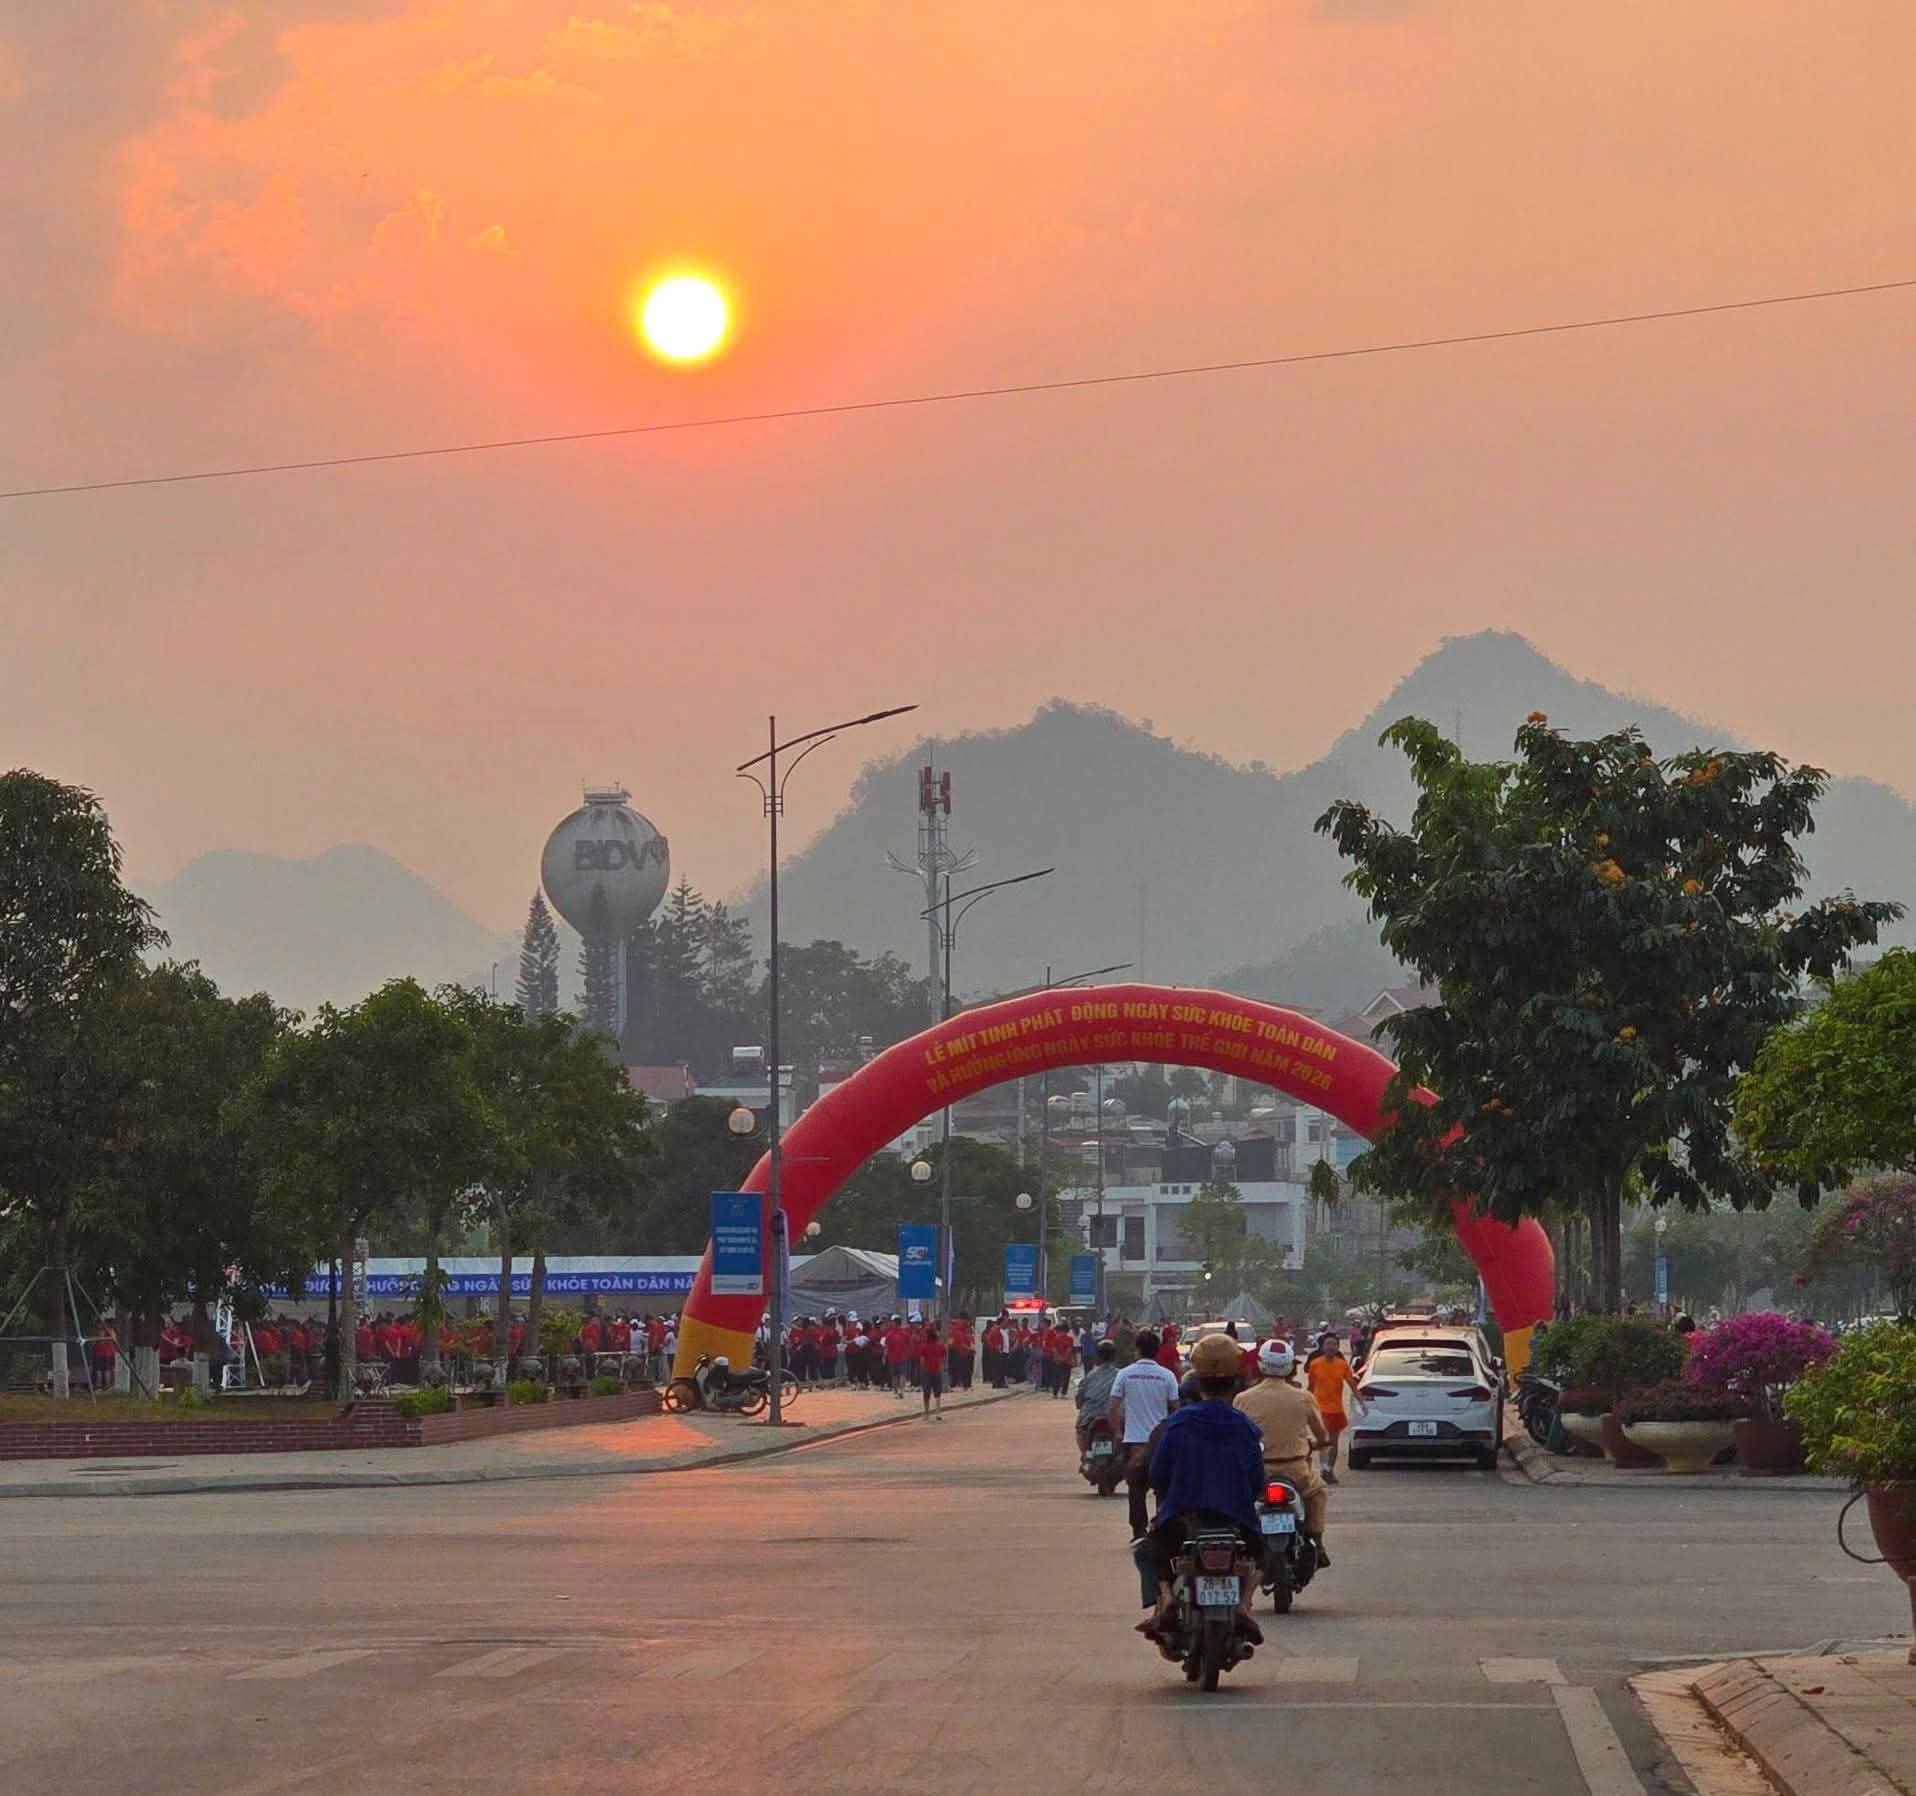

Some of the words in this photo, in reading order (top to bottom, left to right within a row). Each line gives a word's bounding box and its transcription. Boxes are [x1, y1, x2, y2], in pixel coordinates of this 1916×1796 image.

[978, 1022, 1018, 1047] TINH
[1020, 1008, 1064, 1033] PHÁT
[1071, 1001, 1118, 1024] ĐỘNG
[1123, 1000, 1168, 1021] NGÀY
[1172, 1003, 1206, 1025] SỨC
[1257, 1019, 1300, 1048] TOÀN
[1301, 1035, 1337, 1062] DÂN
[1044, 1032, 1088, 1057] NGÀY
[1094, 1026, 1128, 1048] SỨC
[1131, 1025, 1176, 1049] KHỎE
[1181, 1028, 1211, 1053] THẾ
[1291, 1060, 1335, 1090] 2026
[464, 1278, 501, 1291] NGÀ
[512, 1276, 532, 1291] SỨ
[547, 1276, 588, 1290] KHỎE
[591, 1275, 633, 1289] TOÀN
[637, 1276, 669, 1289] DÂN
[674, 1275, 697, 1288] NĂ
